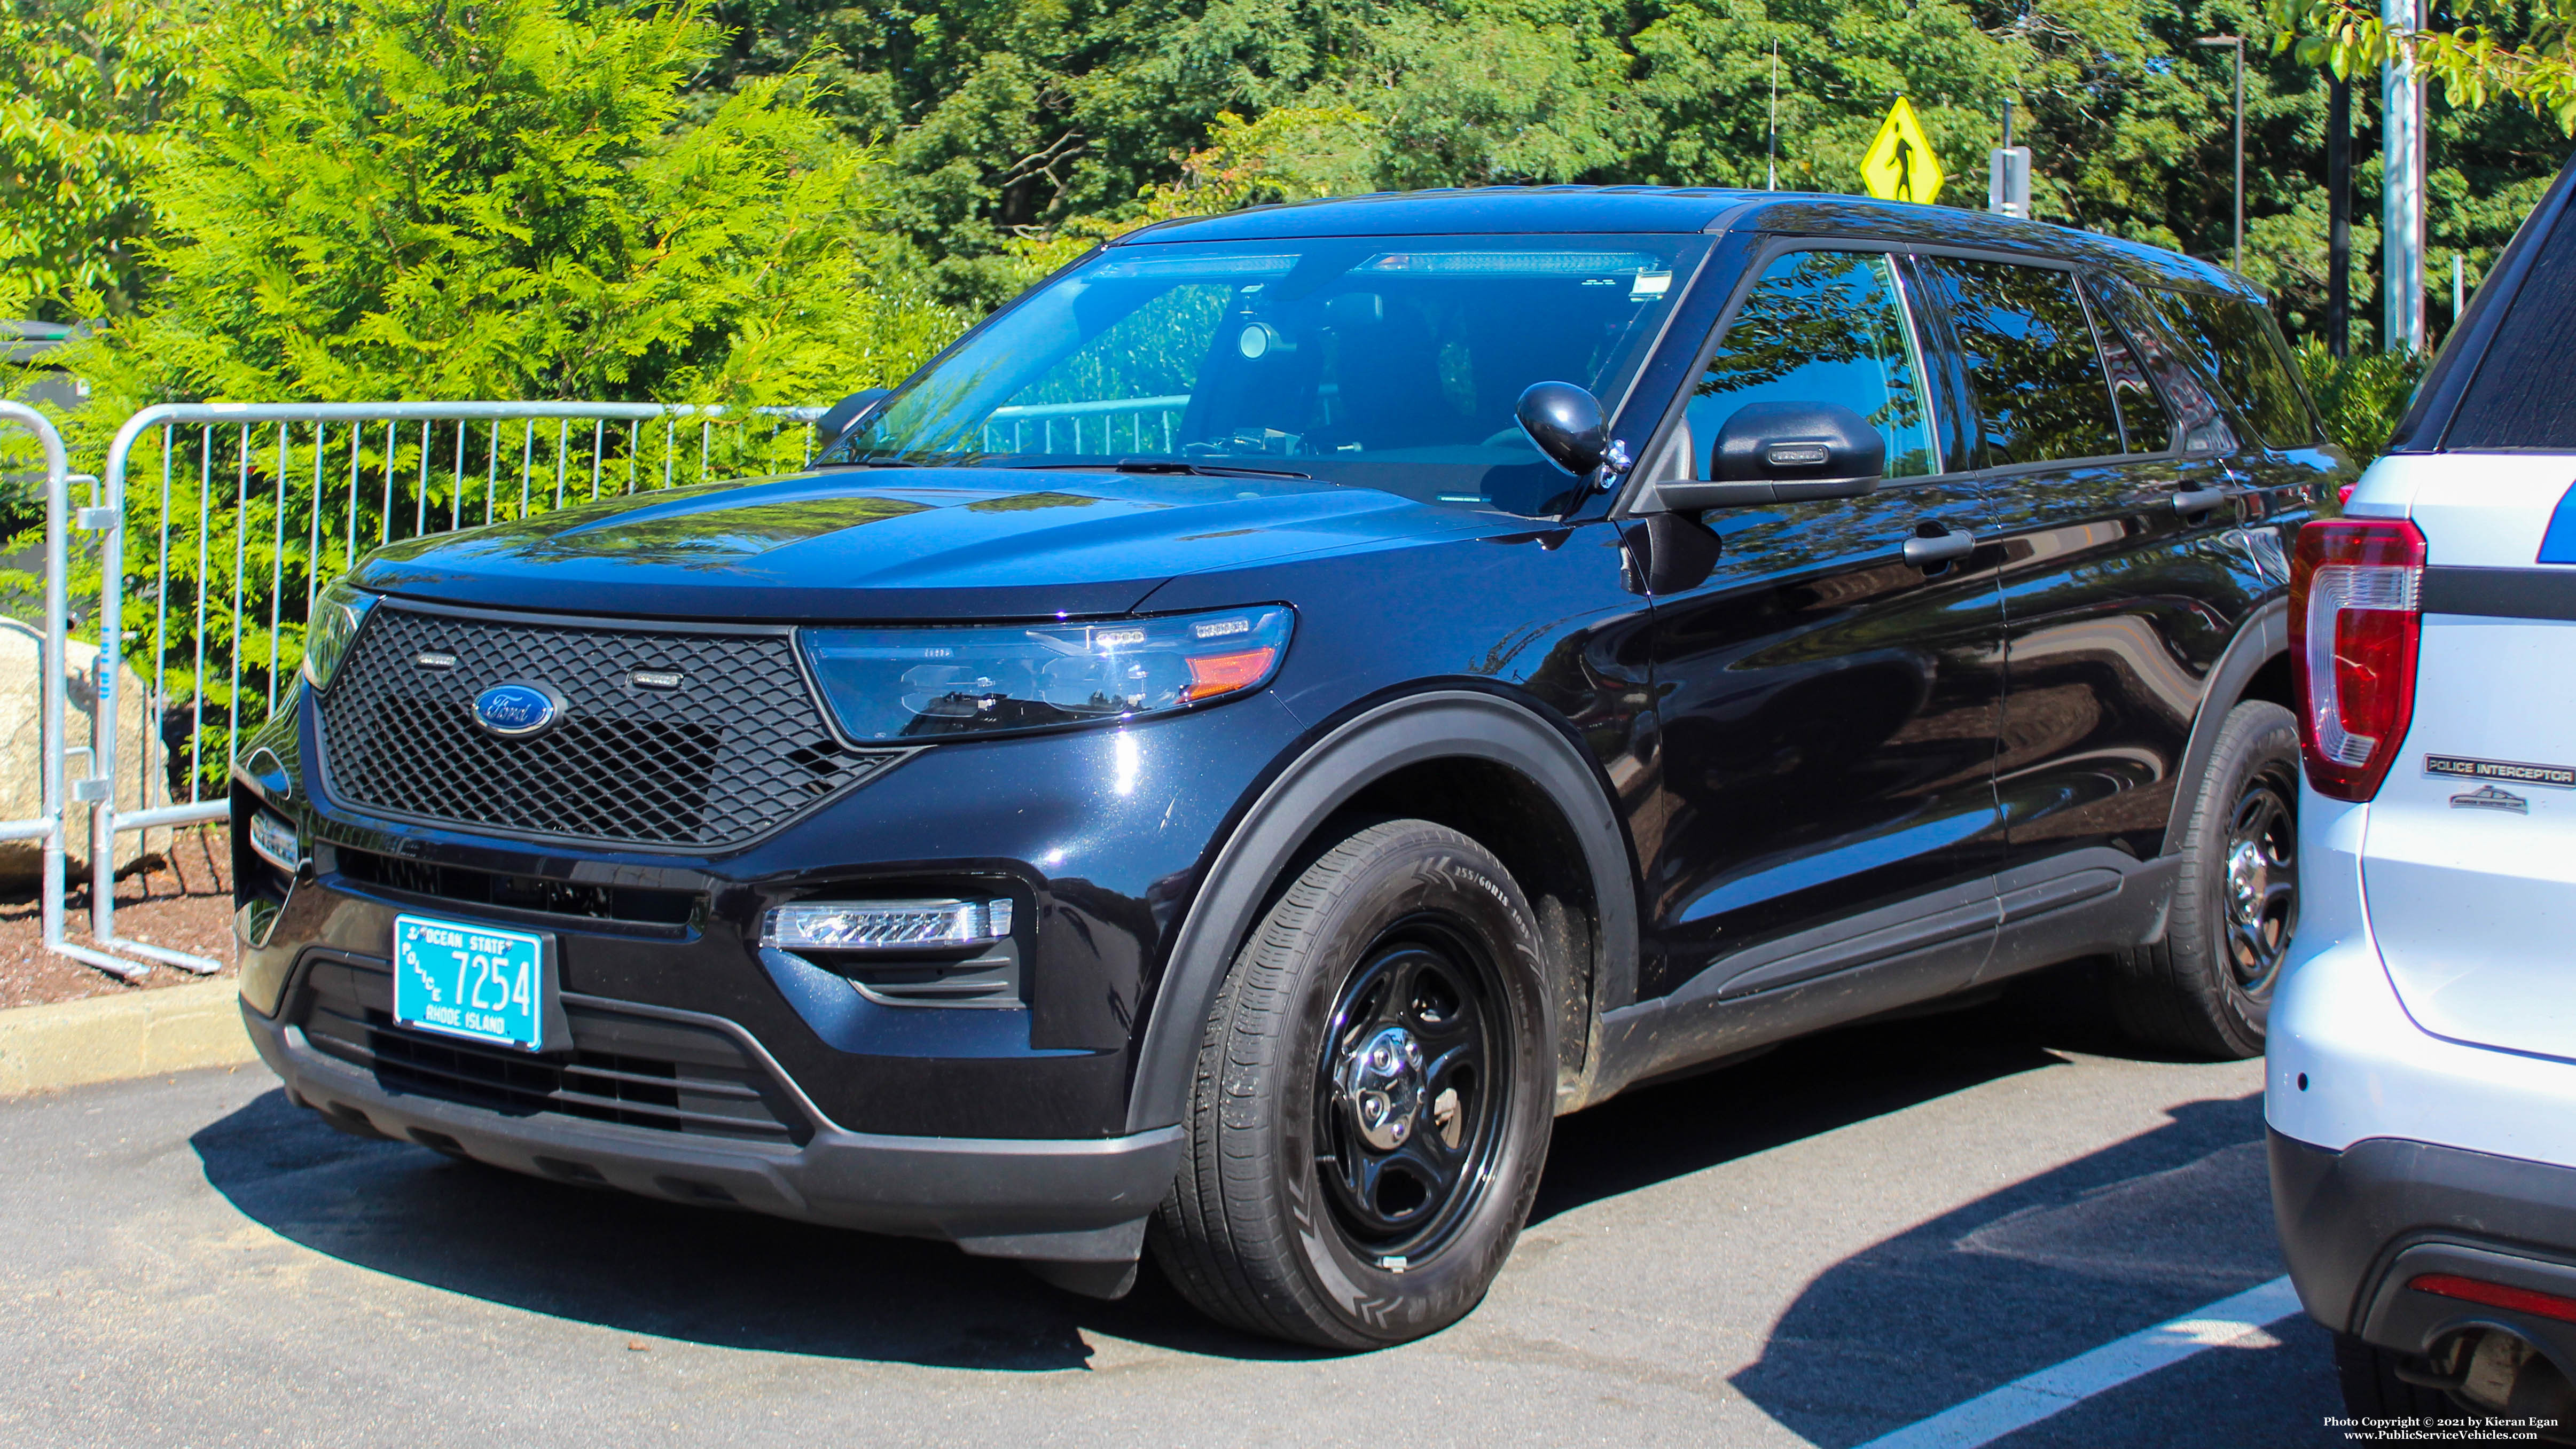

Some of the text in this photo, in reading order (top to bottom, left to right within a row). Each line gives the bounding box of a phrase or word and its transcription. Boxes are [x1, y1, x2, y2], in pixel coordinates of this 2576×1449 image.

[486, 694, 531, 722] Ford
[2428, 759, 2573, 782] POLICE INTERCEPTOR
[426, 928, 463, 949] OCEAN
[401, 942, 442, 1002] POLICE
[451, 950, 530, 1016] 7254
[426, 1004, 505, 1035] RHODE ISLAND
